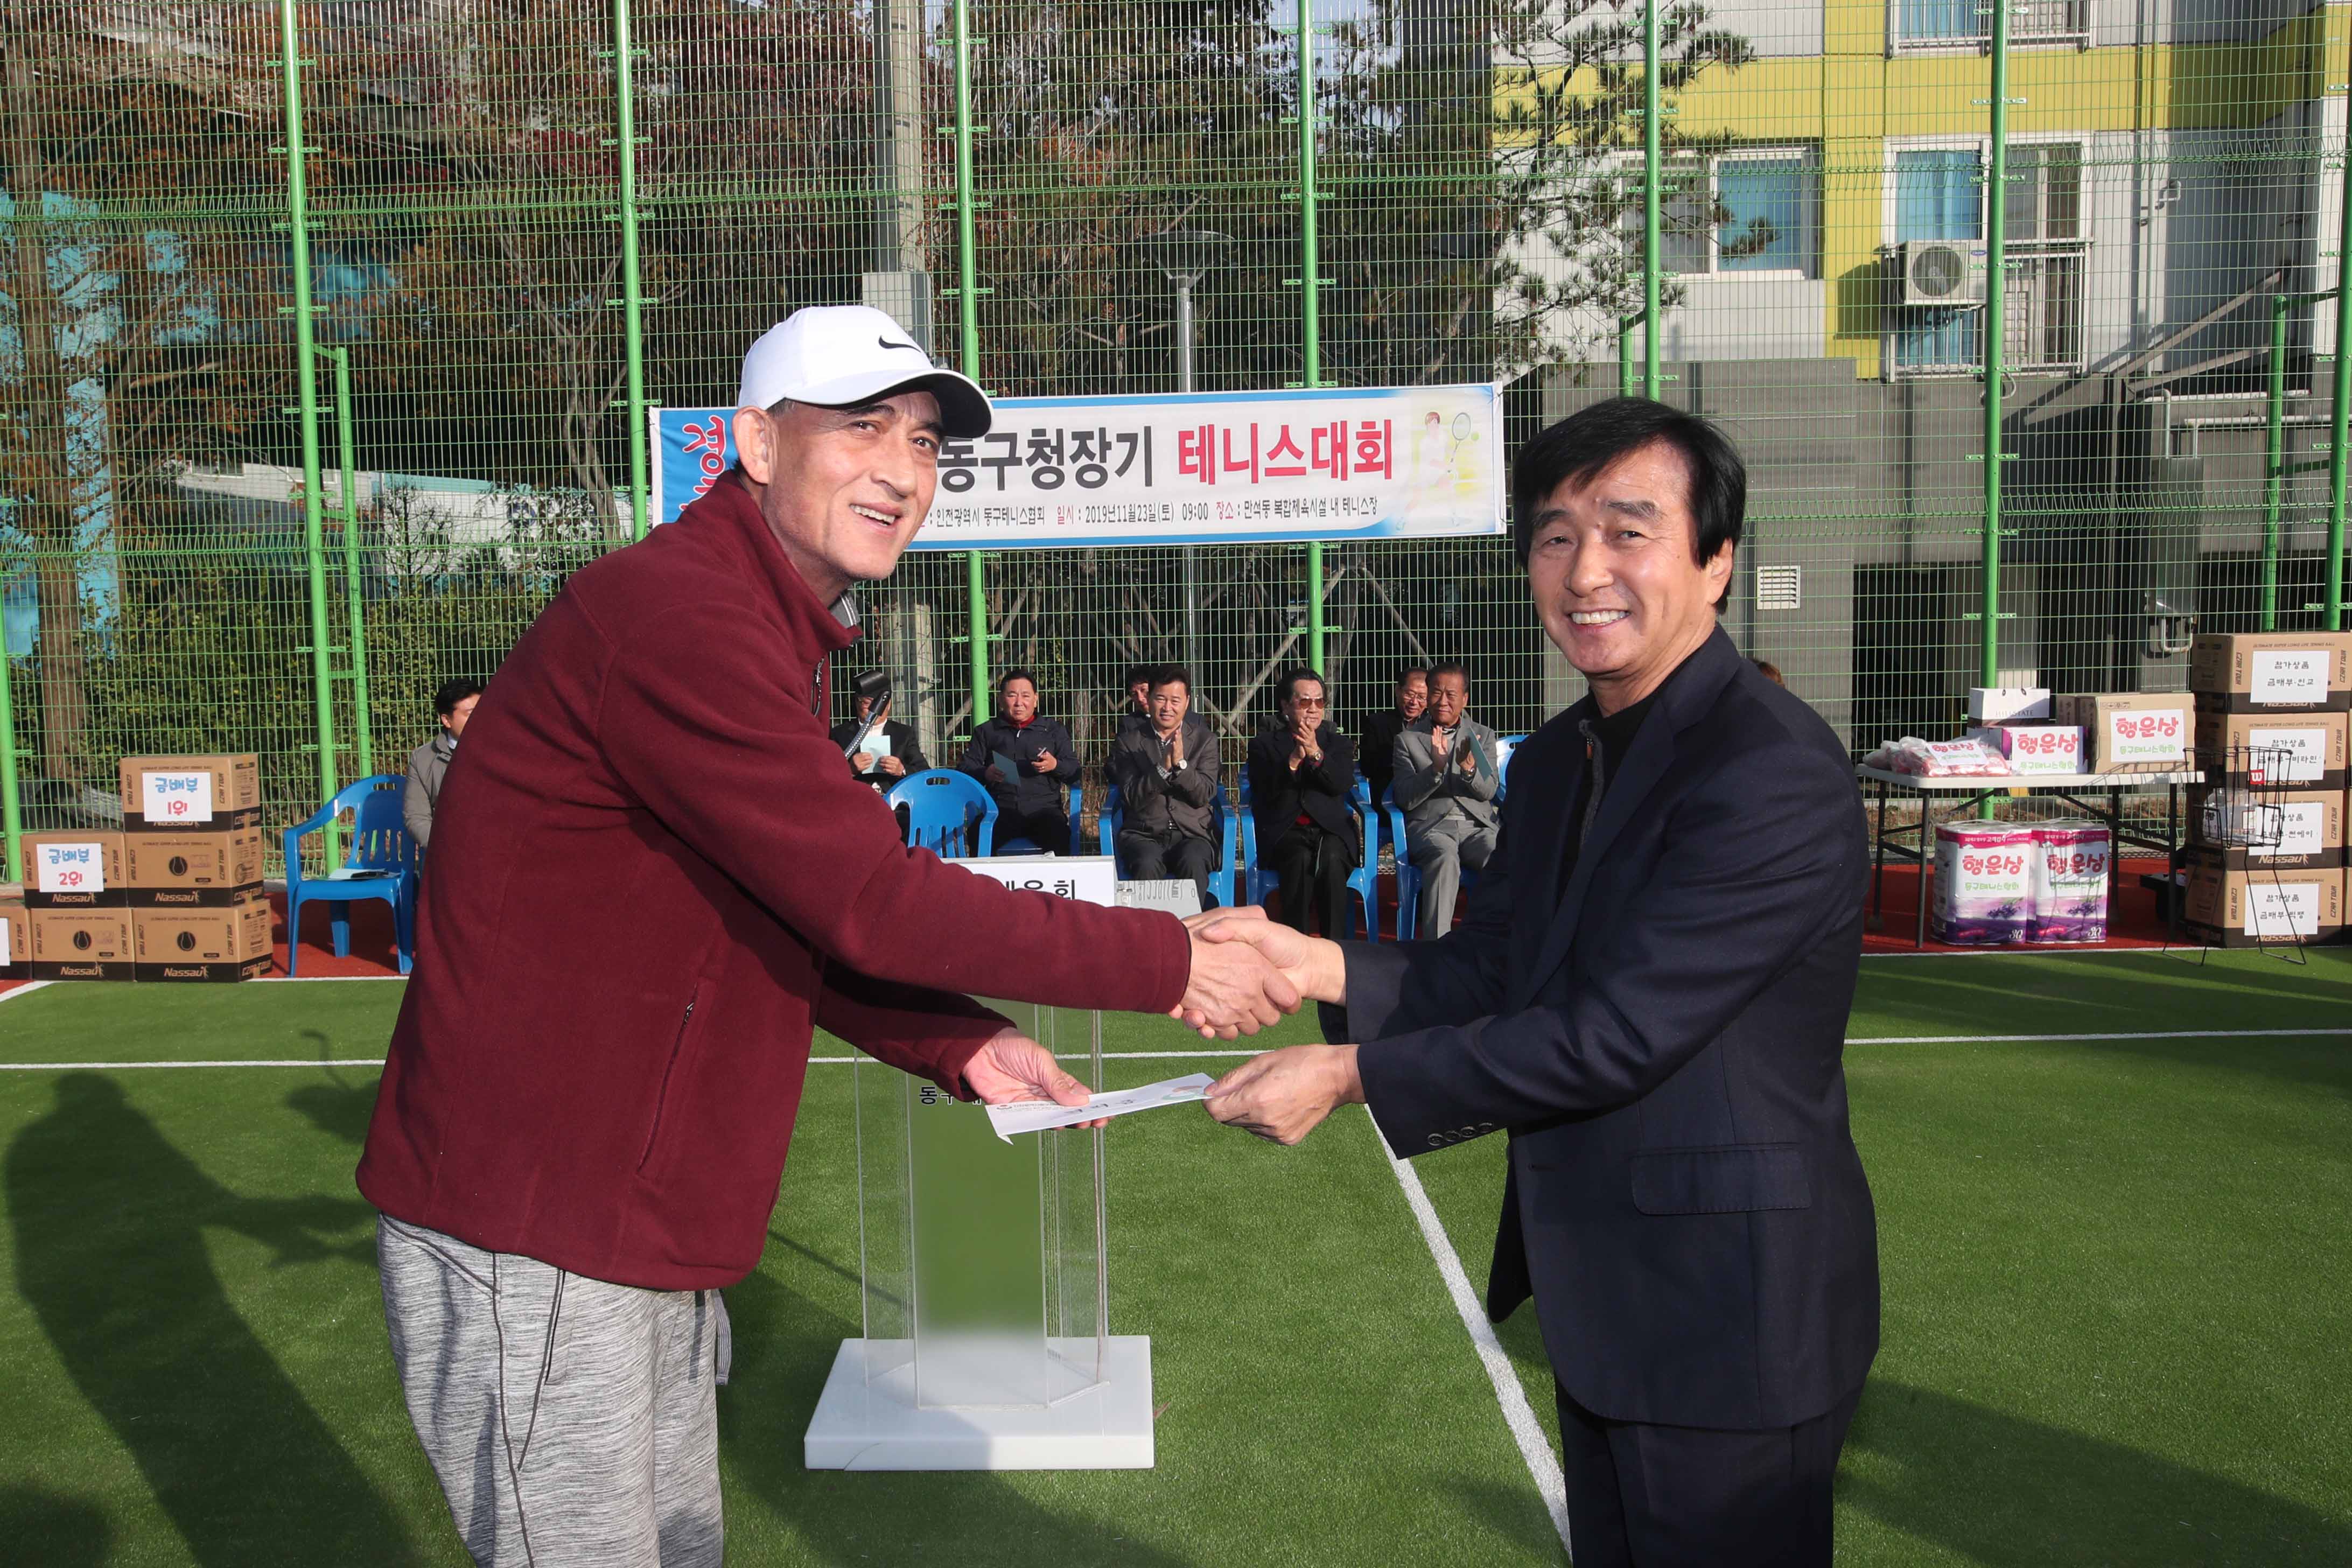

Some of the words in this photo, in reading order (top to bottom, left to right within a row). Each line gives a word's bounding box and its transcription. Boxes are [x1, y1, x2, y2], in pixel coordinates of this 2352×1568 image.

[937, 425, 1152, 493] 동구청장기
[1178, 419, 1392, 485] 테니스대회
[936, 508, 980, 527] 인천광역시
[984, 506, 1045, 527] 동구테니스협회
[1057, 505, 1074, 525] 일시
[1182, 502, 1208, 521] 09:00
[1216, 501, 1234, 520] 장소
[1244, 500, 1271, 520] 만석동
[1275, 498, 1327, 519] 복합체육시설
[1331, 498, 1339, 517] 내
[1343, 496, 1377, 516] 테니스장
[2274, 660, 2309, 669] 참가상품
[2116, 716, 2179, 739] 행운상
[2017, 733, 2078, 754] 행운상
[2271, 739, 2306, 747] 참가상품
[2047, 853, 2105, 874] 행운상
[2258, 855, 2303, 864] Nassau
[1962, 855, 2024, 876] 행운상
[59, 871, 83, 886] 2위
[52, 893, 91, 903] Nassau
[155, 892, 194, 902] Nassau
[2266, 894, 2299, 902] 참가상품
[60, 967, 98, 975] Nassau
[164, 968, 204, 977] Nassau
